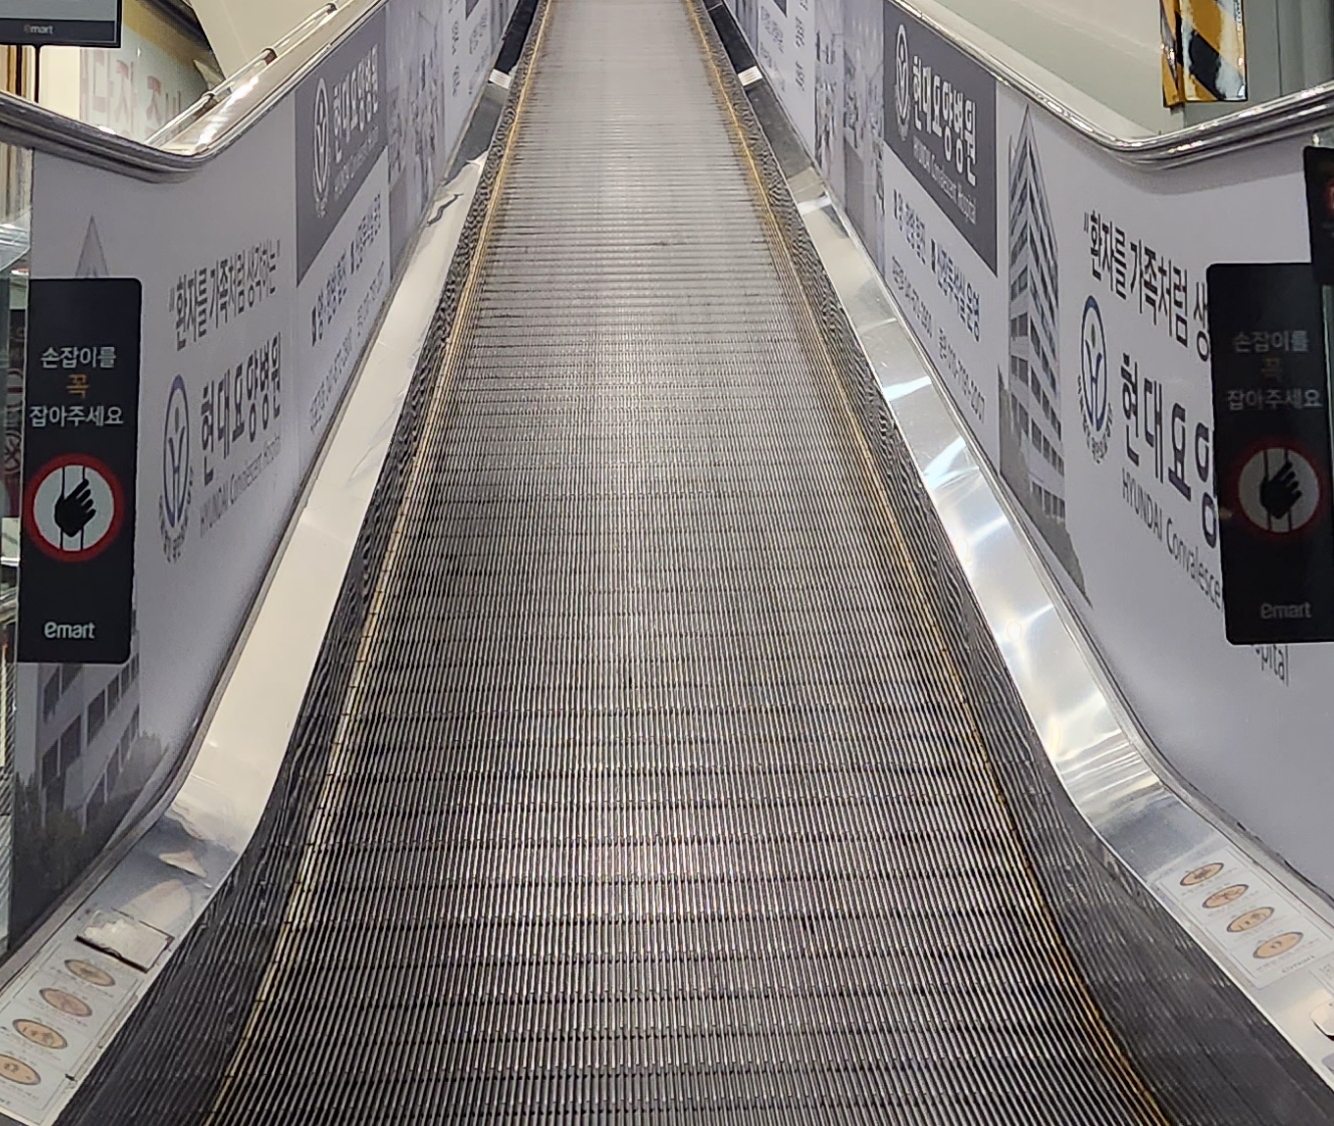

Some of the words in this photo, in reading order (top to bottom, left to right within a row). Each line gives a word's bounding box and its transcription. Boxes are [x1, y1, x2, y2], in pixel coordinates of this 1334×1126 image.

[913, 55, 976, 187] 현대요양병원
[209, 250, 245, 329] 가족처럼
[1130, 239, 1188, 348] 가족처럼
[1234, 330, 1309, 352] 손잡이를
[40, 346, 116, 369] 손잡이를
[66, 375, 90, 398] 꼭
[201, 332, 280, 486] 현대요양병원
[1227, 387, 1323, 411] 잡아주세요
[29, 405, 124, 428] 잡아주세요
[1121, 352, 1217, 549] 현대요양
[1122, 468, 1163, 542] HYUNDAI
[1166, 517, 1224, 613] Convalesce
[1255, 644, 1290, 687] pital
[1260, 601, 1312, 621] emart
[44, 621, 96, 640] emart
